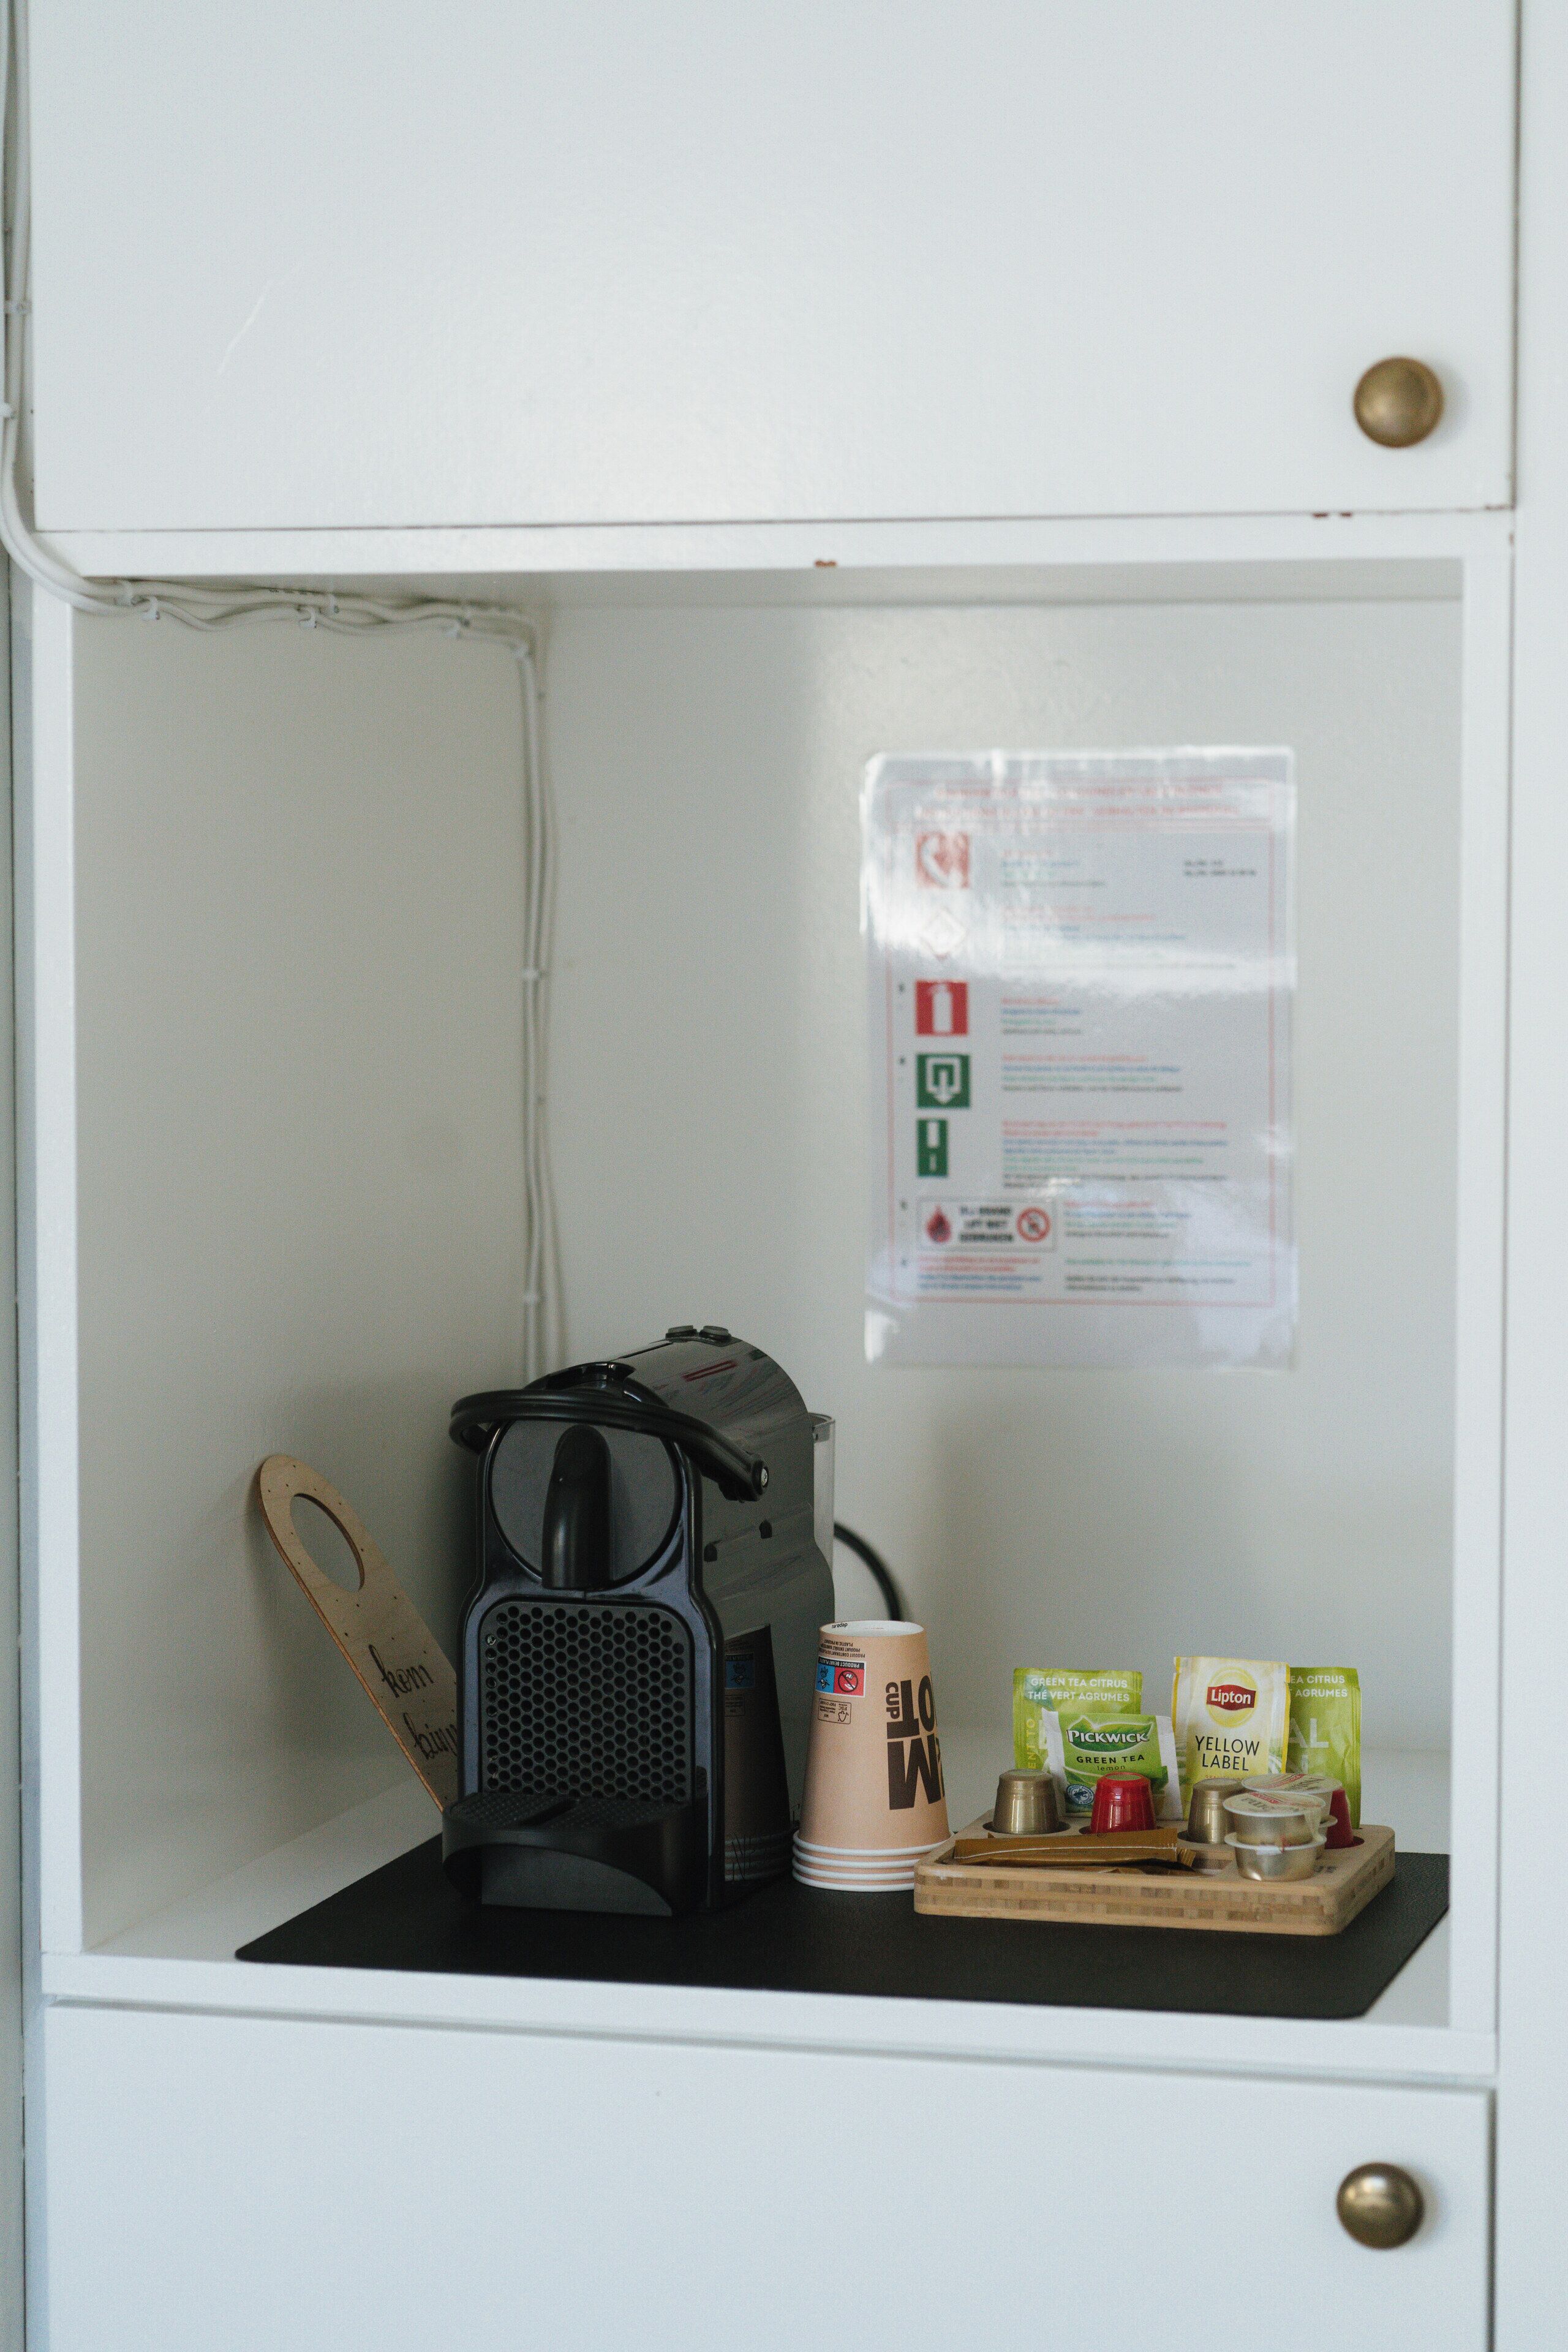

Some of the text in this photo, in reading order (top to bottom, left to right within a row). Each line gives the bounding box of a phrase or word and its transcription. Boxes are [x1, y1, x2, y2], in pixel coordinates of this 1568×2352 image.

[1031, 1678, 1128, 1688] GREEN TEA CITRUS
[1306, 1675, 1346, 1684] CITRUS
[885, 1682, 900, 1719] CUP
[1028, 1689, 1130, 1702] THÉ VERT AGRUMES
[1211, 1689, 1251, 1705] Lipton
[1295, 1689, 1348, 1698] AGRUMES
[1066, 1728, 1150, 1744] PICKWICK
[1195, 1735, 1260, 1756] YELLOW
[1202, 1754, 1249, 1771] LABEL
